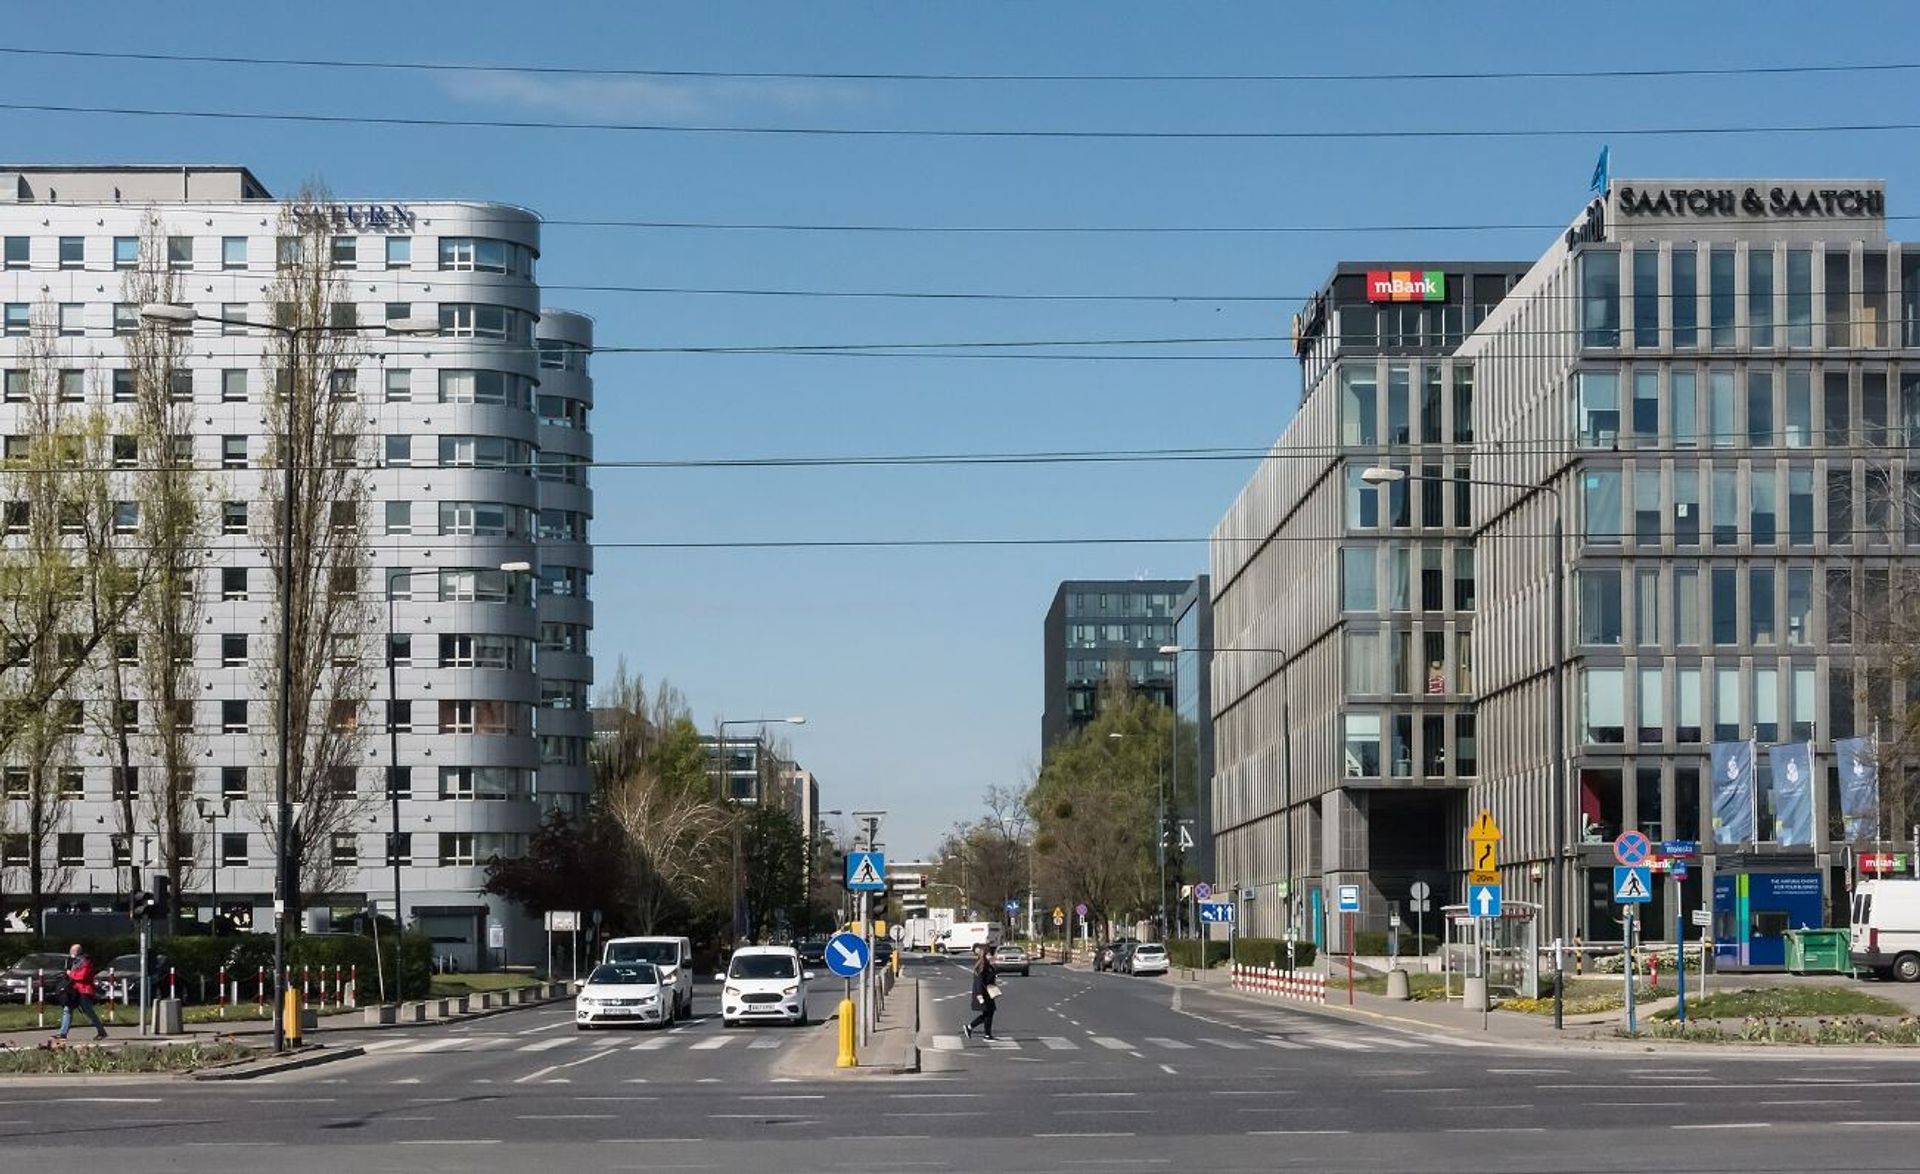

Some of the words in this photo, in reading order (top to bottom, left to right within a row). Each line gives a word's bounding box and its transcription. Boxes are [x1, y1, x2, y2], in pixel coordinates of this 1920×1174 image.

[1619, 187, 1735, 216] SAATCHI
[1742, 187, 1766, 216] &
[1770, 187, 1884, 216] SAATCHI
[1375, 278, 1436, 293] mBank
